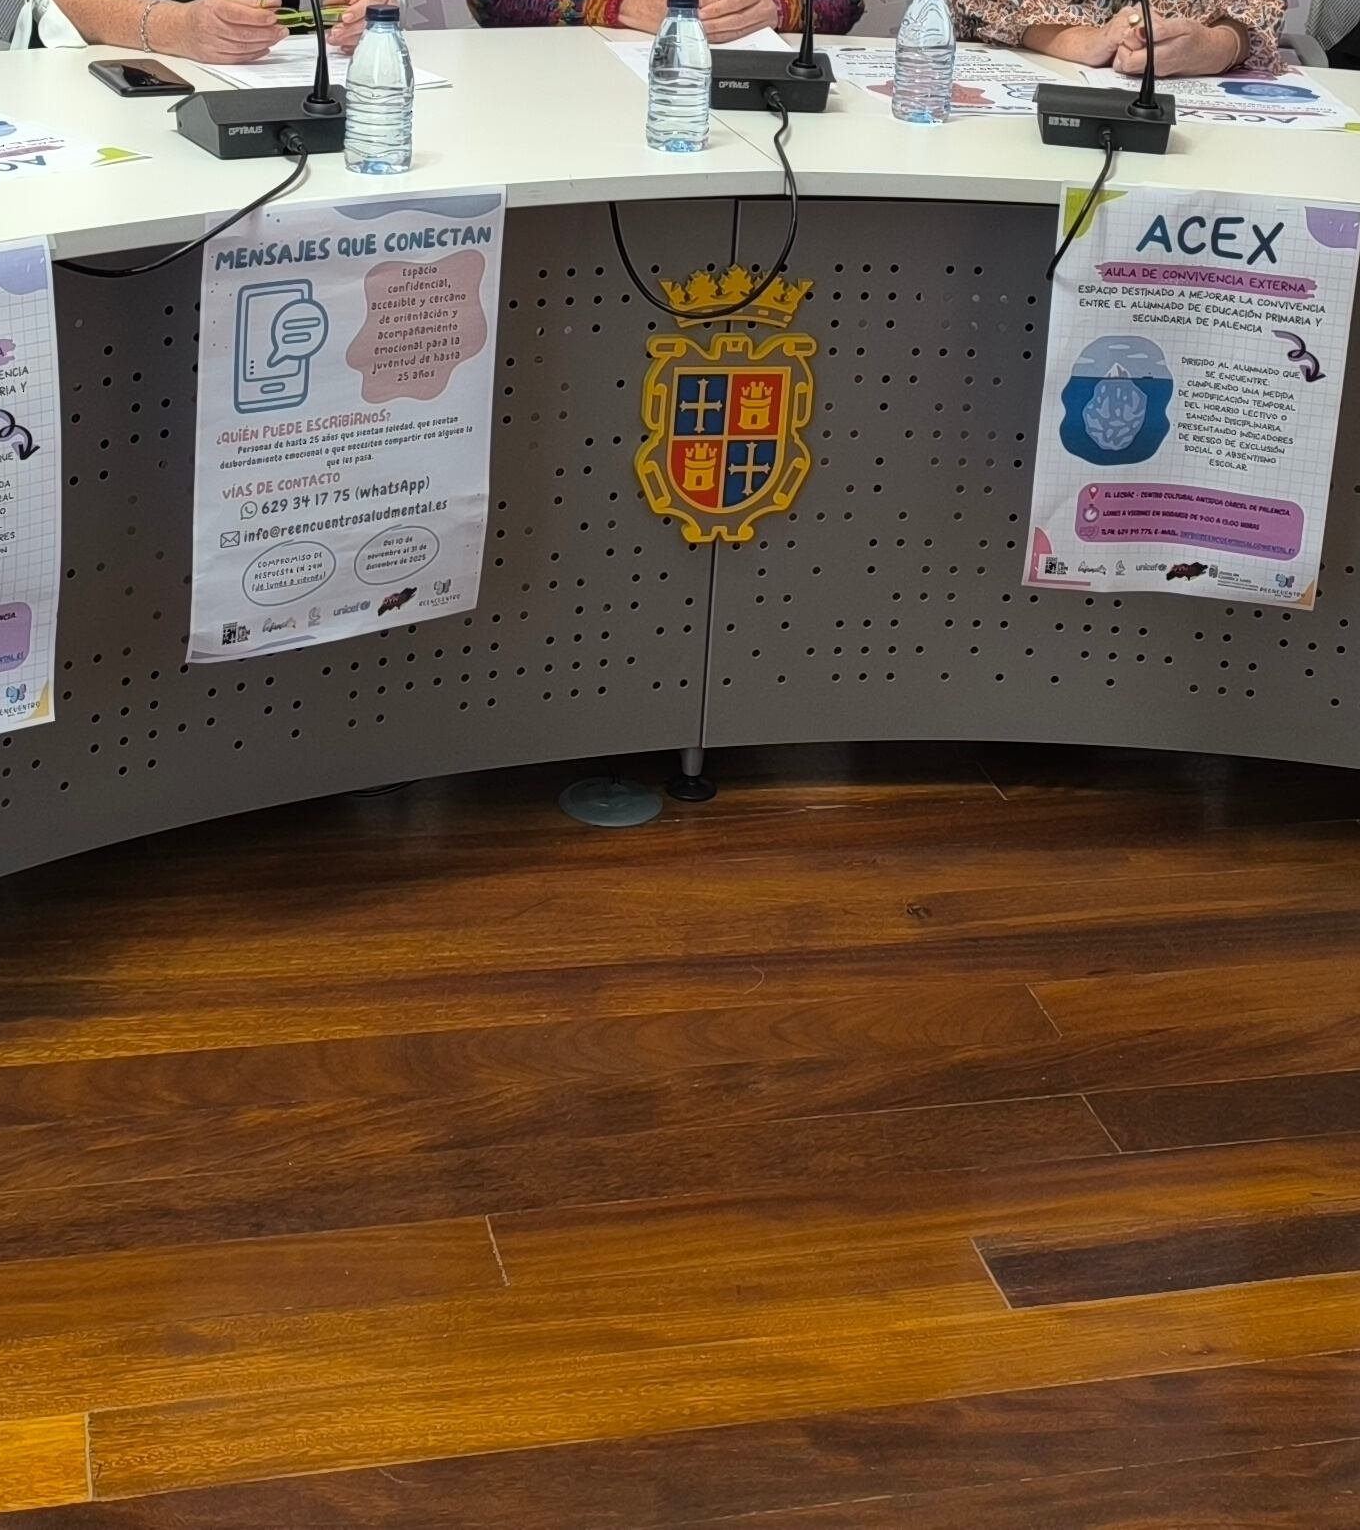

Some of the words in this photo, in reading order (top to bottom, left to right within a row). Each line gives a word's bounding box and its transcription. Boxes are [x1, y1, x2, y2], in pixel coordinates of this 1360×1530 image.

[214, 237, 330, 271] MENSAJES
[337, 233, 376, 257] QUE
[383, 225, 491, 252] CONECTAN
[1135, 214, 1284, 265] ACEX
[402, 262, 437, 279] Espacio
[1104, 267, 1136, 277] AULA
[1141, 267, 1157, 279] DE
[1161, 269, 1243, 286] CONVIVENCIA
[1248, 277, 1306, 292] EXTERNA
[387, 277, 450, 293] confidencial,
[370, 296, 416, 310] accesible
[419, 298, 425, 307] y
[429, 292, 466, 303] cercano
[1077, 284, 1118, 295] ESPACIO
[1121, 285, 1174, 296] DESTINADO
[1177, 289, 1185, 297] A
[1188, 290, 1235, 303] MEJORAR
[1238, 295, 1253, 305] LA
[1256, 298, 1325, 313] CONVIVENCIA
[378, 314, 390, 324] de
[393, 308, 448, 323] orientación
[451, 309, 457, 318] y
[1079, 297, 1110, 308] ENTRE
[1113, 299, 1126, 308] EL
[1130, 300, 1184, 310] ALUMNADO
[1187, 302, 1201, 312] DE
[1204, 304, 1262, 319] EDUCACIÓN
[1265, 311, 1311, 325] PRIMARIA
[1315, 317, 1322, 326] Y
[377, 322, 458, 340] acompañamiento
[1132, 313, 1191, 325] SECUNDARIA
[1195, 316, 1209, 326] DE
[1212, 318, 1262, 333] PALENCIA
[374, 340, 422, 355] emocional
[426, 337, 447, 352] para
[450, 336, 459, 345] la
[373, 354, 416, 374] juventud
[418, 353, 430, 363] de
[433, 350, 462, 363] hasta
[397, 371, 409, 381] 25
[412, 369, 434, 379] años
[20, 381, 30, 392] Y
[262, 420, 302, 438] PUEDE
[222, 482, 252, 499] VÍAS
[256, 480, 273, 494] DE
[277, 471, 340, 491] CONTACTO
[261, 498, 288, 514] 629
[292, 494, 310, 509] 34
[315, 491, 328, 505] 17
[333, 488, 349, 503] 75
[243, 499, 447, 542] info@reencuentrosaludmental.es
